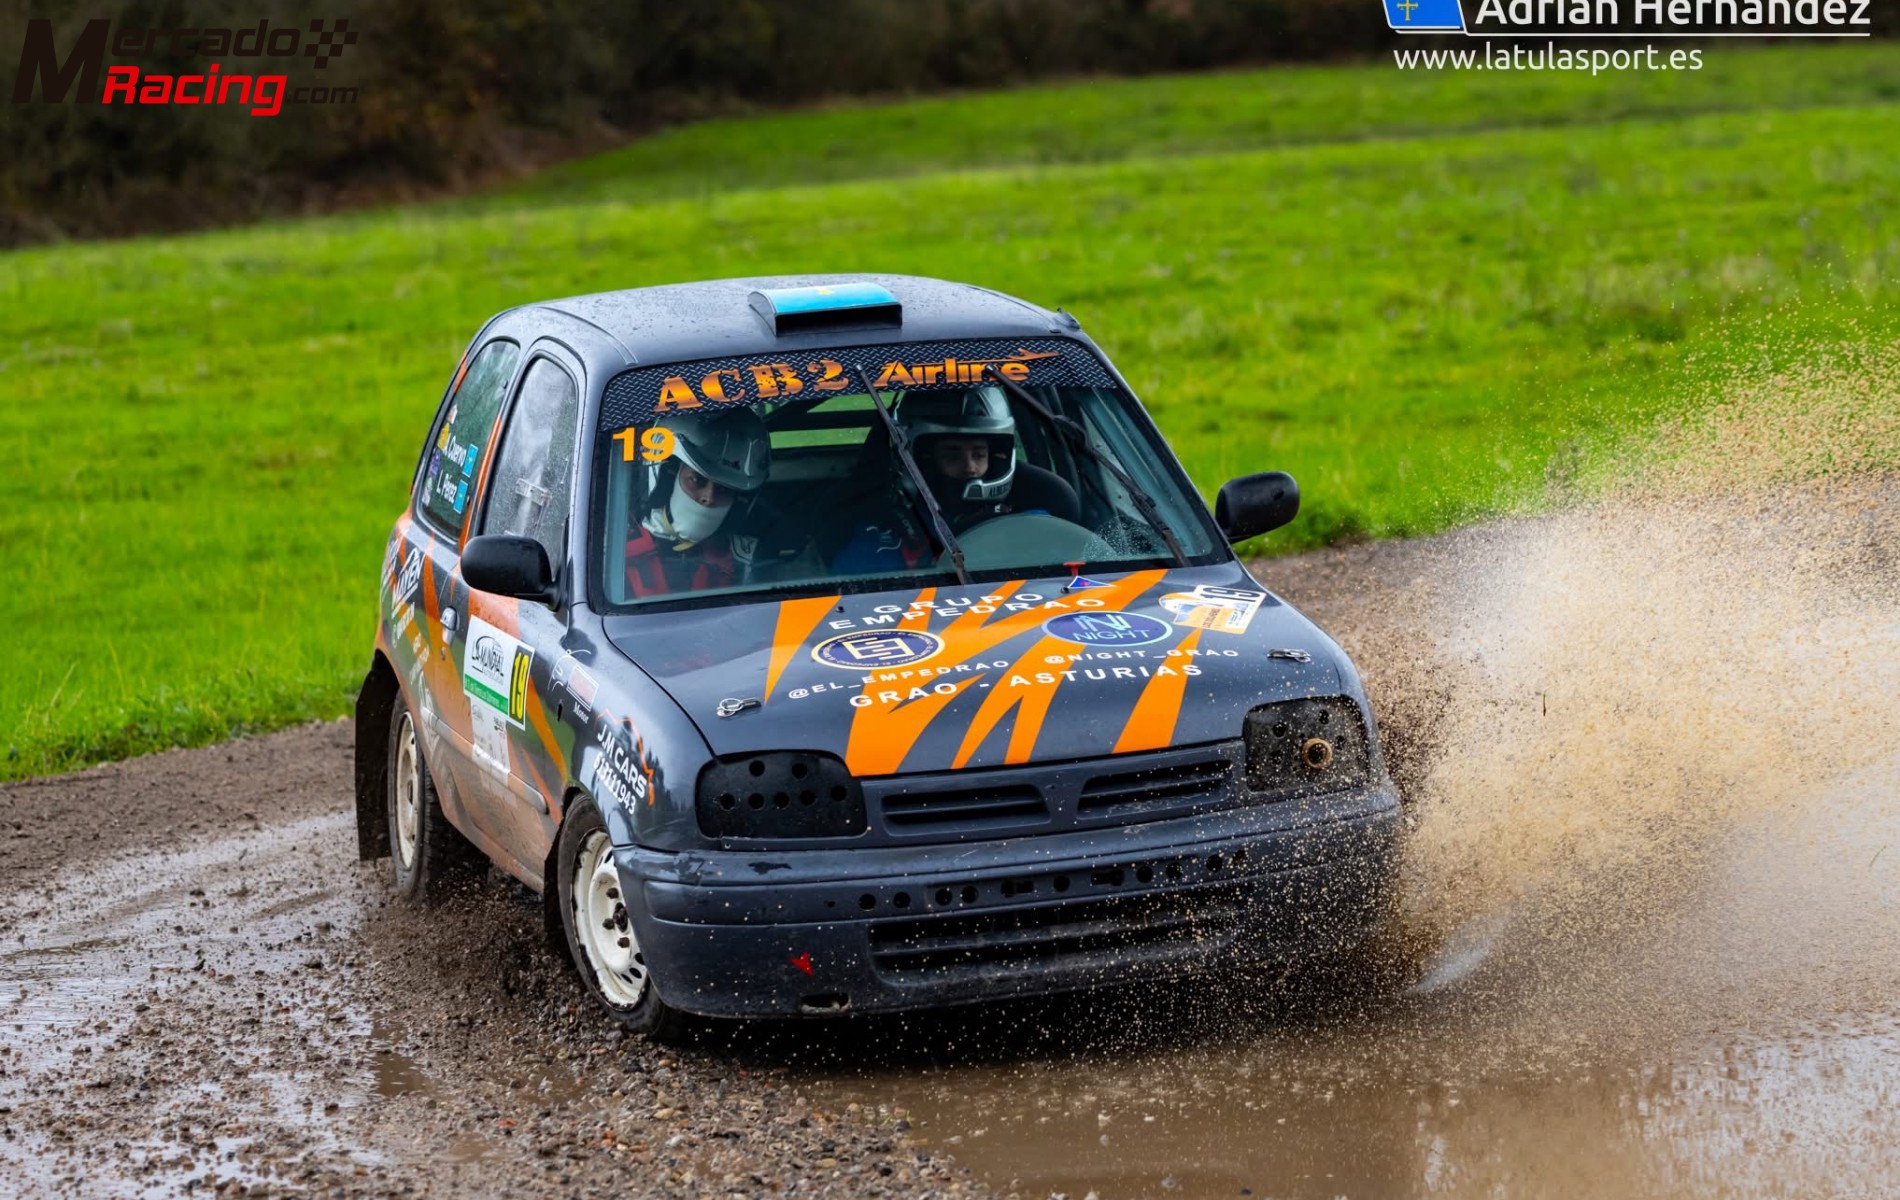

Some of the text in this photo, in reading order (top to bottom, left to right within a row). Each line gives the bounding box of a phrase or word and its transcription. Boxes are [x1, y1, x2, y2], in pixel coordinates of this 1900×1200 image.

[612, 426, 676, 462] 19
[828, 598, 1105, 630] EMPEDRAO
[873, 592, 1043, 615] GRUPO
[1072, 629, 1151, 641] NIGHT
[1044, 649, 1240, 665] @NIGHT_GRAO
[511, 652, 530, 719] 19
[788, 660, 1009, 699] @EL_EMPEDRAO
[849, 683, 958, 708] GRAO
[1009, 664, 1203, 687] ASTURIAS
[573, 703, 590, 724] Motor
[593, 751, 637, 815] 613111943
[614, 746, 648, 799] CARS
